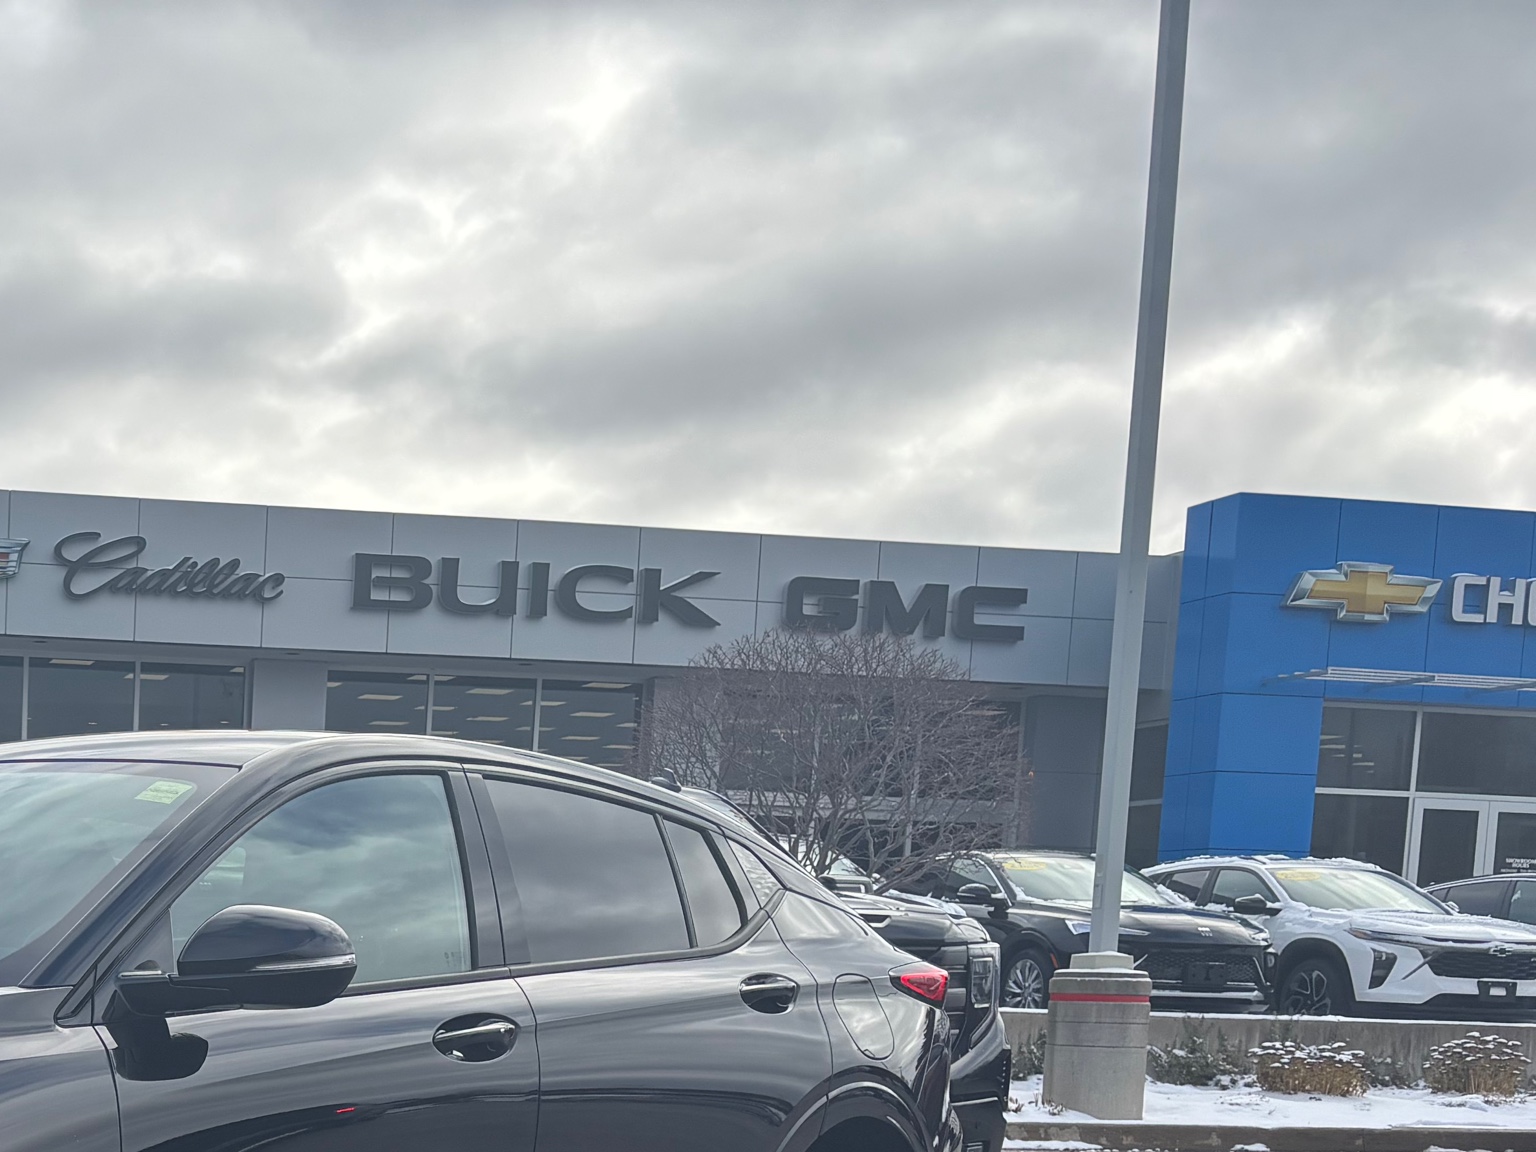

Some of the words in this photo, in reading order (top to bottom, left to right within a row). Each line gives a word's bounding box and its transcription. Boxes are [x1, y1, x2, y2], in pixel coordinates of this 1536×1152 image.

[53, 531, 286, 601] Cadillac
[352, 552, 722, 628] BUICK
[782, 575, 1029, 643] GMC
[1451, 576, 1536, 626] CH
